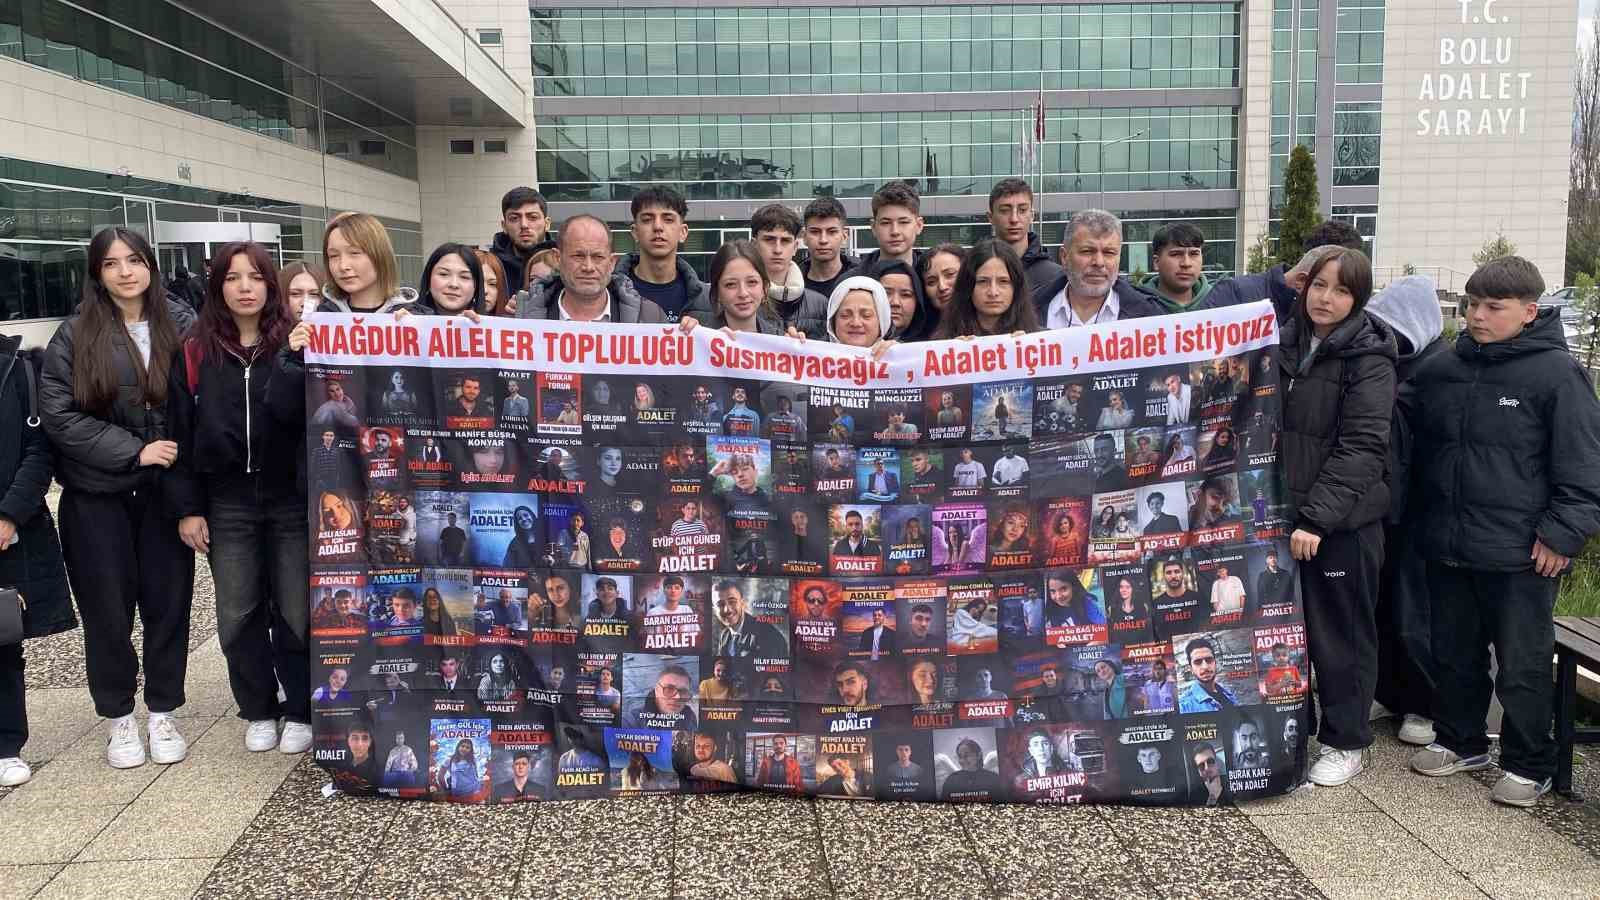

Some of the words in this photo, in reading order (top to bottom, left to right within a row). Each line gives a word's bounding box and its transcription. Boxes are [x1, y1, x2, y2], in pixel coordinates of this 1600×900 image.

[1459, 0, 1509, 24] T.C.
[1440, 37, 1511, 65] BOLU
[1418, 72, 1531, 100] ADALET
[1417, 108, 1526, 136] SARAYI
[309, 316, 420, 357] MAĞDUR
[428, 320, 534, 361] AİLELER
[543, 328, 695, 366] TOPLULUĞU
[710, 338, 889, 385] Susmayacağız
[924, 344, 1008, 376] Adalet
[1016, 339, 1062, 376] için
[1088, 327, 1167, 363] Adalet
[1175, 313, 1275, 354] istiyoruz
[1093, 376, 1138, 391] ADALET
[637, 411, 676, 421] ADALET
[455, 429, 486, 438] HANİFE
[468, 439, 504, 447] KONYAR
[1065, 460, 1089, 469] ADALET
[1249, 455, 1276, 466] ADALET
[1129, 464, 1157, 477] ADALET
[1162, 460, 1196, 476] ADALET!
[528, 479, 586, 494] ADALET
[817, 479, 854, 491] ADALET!
[952, 489, 978, 497] ADALET
[941, 511, 977, 520] ADALET
[470, 515, 514, 528] ADALET
[652, 536, 674, 548] EYÜP
[675, 536, 692, 547] CAN
[693, 533, 720, 545] GÜNER
[1198, 529, 1236, 544] ADALET
[318, 543, 356, 556] ADALET
[659, 555, 716, 573] ADALET
[836, 561, 877, 570] ADALET
[991, 554, 1033, 566] ADALET
[318, 576, 357, 585] ADALET
[373, 574, 417, 585] ADALET!
[481, 577, 519, 586] ADALET
[850, 591, 888, 600] ADALET
[951, 589, 992, 599] ADALET
[1165, 611, 1192, 622] ADALET
[1262, 607, 1293, 617] ADALET
[643, 616, 670, 626] BARAN
[671, 613, 699, 625] CENGİZ
[1113, 620, 1146, 630] ADALET
[583, 624, 629, 636] ADALET
[795, 625, 837, 636] ADALET
[1291, 624, 1304, 634] İÇİN
[532, 632, 577, 644] ADALET
[645, 632, 699, 649] ADALET
[1057, 632, 1094, 642] ADALET
[1256, 632, 1305, 650] ADALET!
[1078, 651, 1103, 660] ADALET
[1128, 645, 1165, 658] ADALET
[323, 657, 351, 665] ADALET
[378, 663, 409, 673] ADALET
[527, 691, 563, 704] ADALET
[434, 703, 465, 711] ADALET
[486, 704, 516, 712] ADALET
[967, 706, 1007, 717] ADALET
[707, 712, 737, 720] ADALET
[911, 714, 955, 727] ADALET
[646, 719, 676, 728] ADALET
[830, 717, 873, 733] ADALET
[441, 730, 482, 739] ADALET
[497, 732, 544, 742] ADALET
[1128, 731, 1166, 743] ADALET
[1185, 729, 1217, 741] ADALET
[617, 741, 658, 753] ADALET
[821, 743, 866, 753] ADALET
[315, 750, 346, 760] ADALET
[556, 773, 605, 786] ADALET
[1228, 769, 1251, 780] BURAK
[1026, 776, 1052, 791] EMİR
[1053, 771, 1086, 789] KILINÇ
[1229, 779, 1245, 793] İÇİN
[1245, 778, 1269, 791] ADALET
